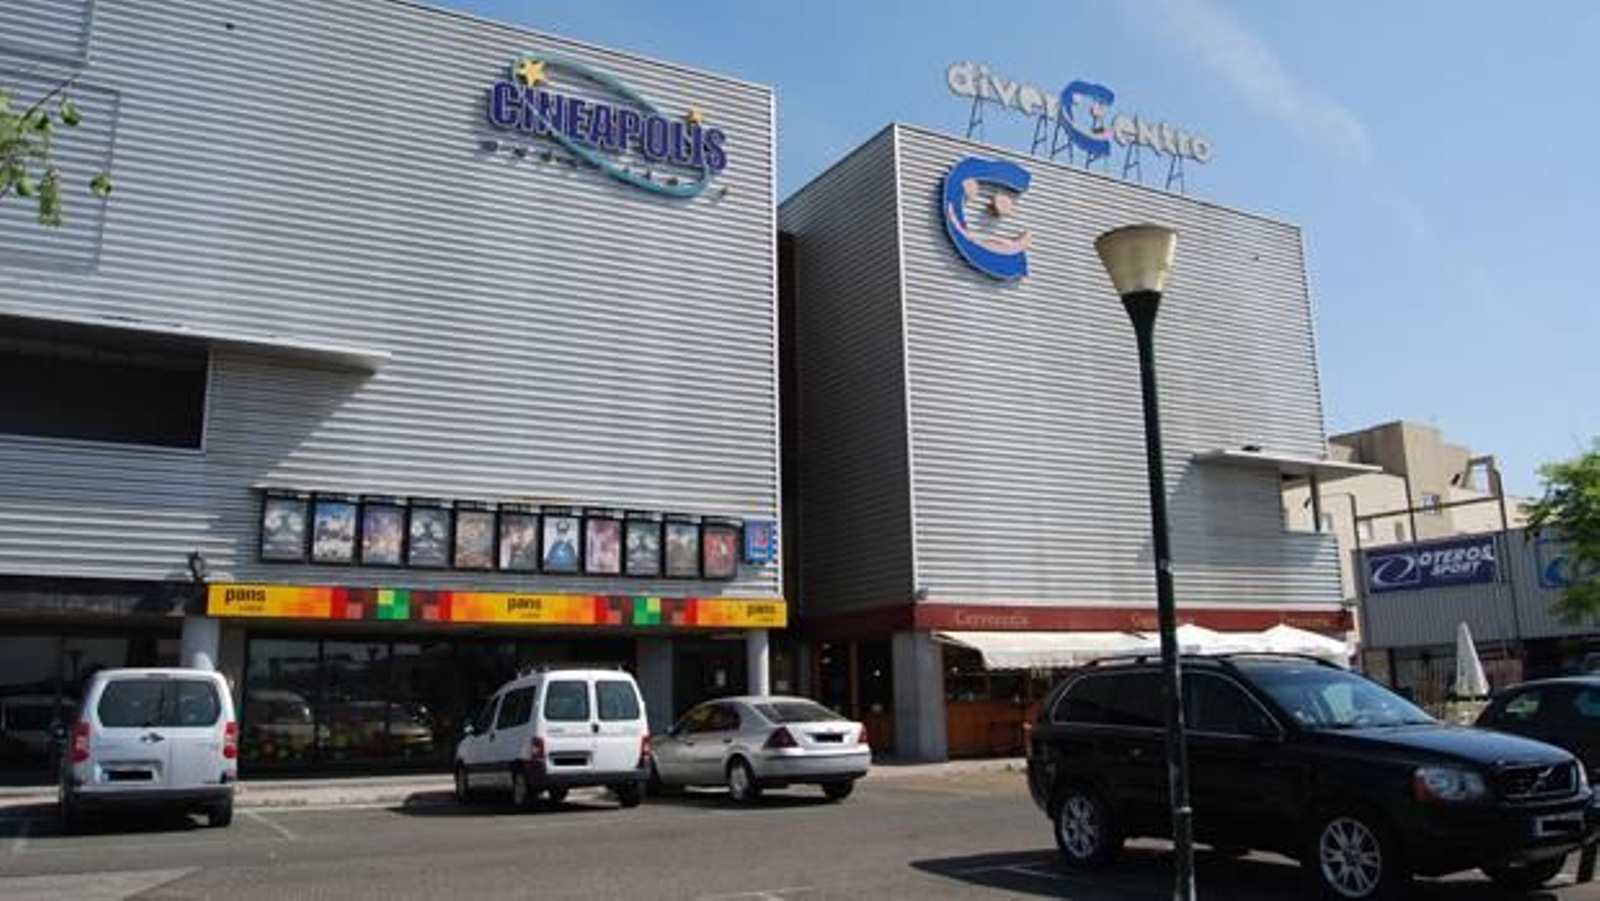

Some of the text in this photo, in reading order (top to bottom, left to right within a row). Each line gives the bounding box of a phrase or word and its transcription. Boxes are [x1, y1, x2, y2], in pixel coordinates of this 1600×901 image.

[489, 80, 728, 171] CINEAPOLIS
[1419, 544, 1495, 567] OTEROS
[1431, 560, 1481, 577] SPORT
[225, 588, 266, 605] pans
[507, 597, 542, 612] pans
[746, 604, 777, 616] pans
